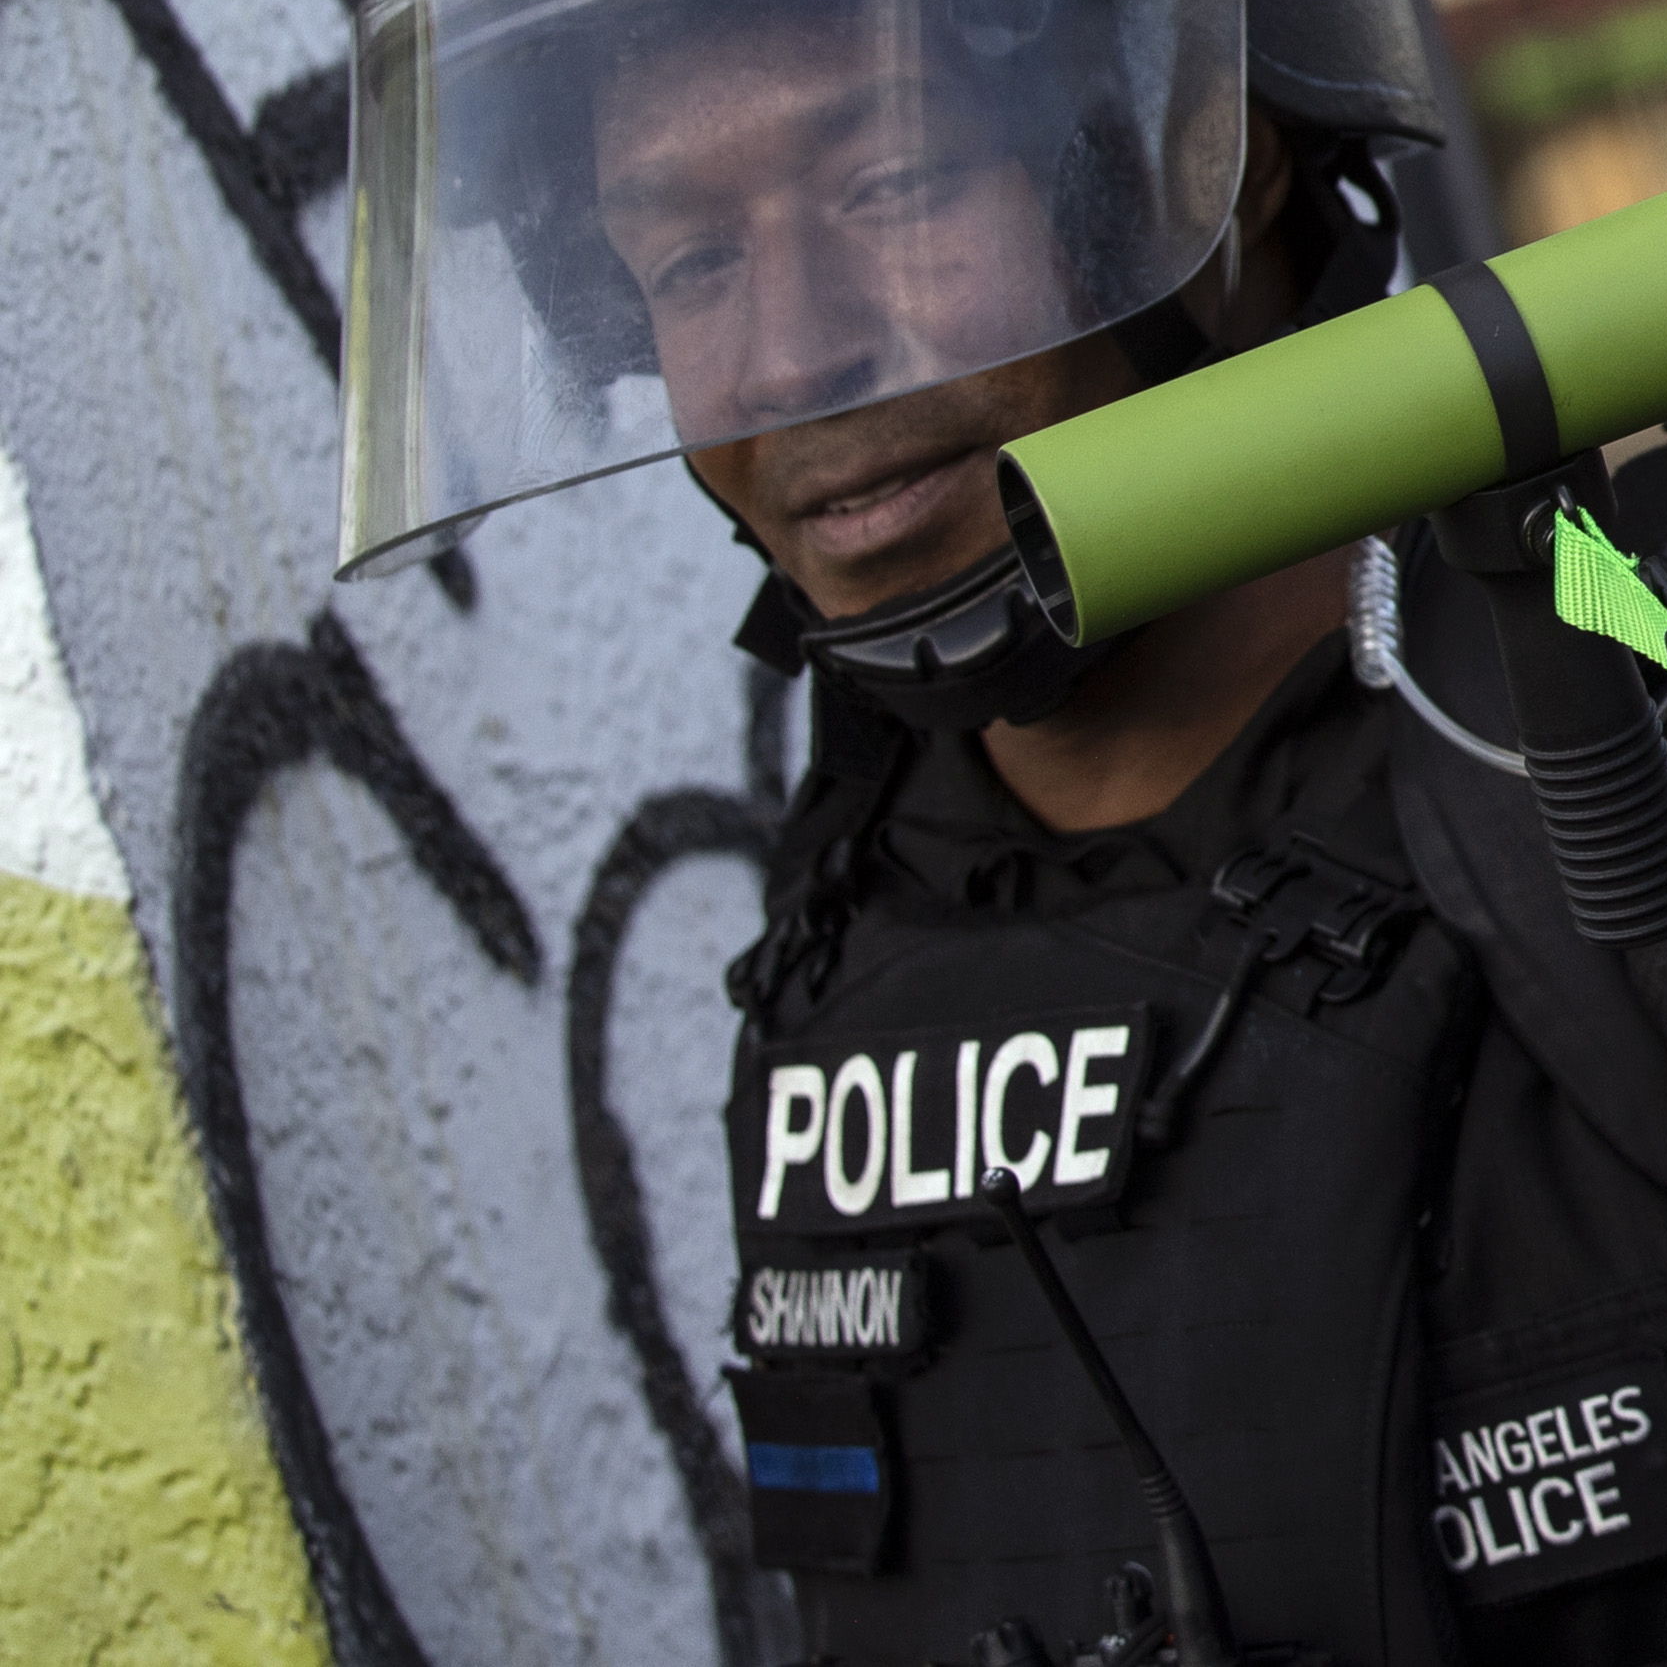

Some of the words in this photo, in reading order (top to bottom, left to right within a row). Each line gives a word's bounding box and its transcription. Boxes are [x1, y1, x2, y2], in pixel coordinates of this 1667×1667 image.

[757, 1025, 1130, 1220] POLICE
[749, 1266, 903, 1348] SHANNON
[1436, 1386, 1651, 1495] ANGELES
[1433, 1460, 1631, 1574] OLICE
